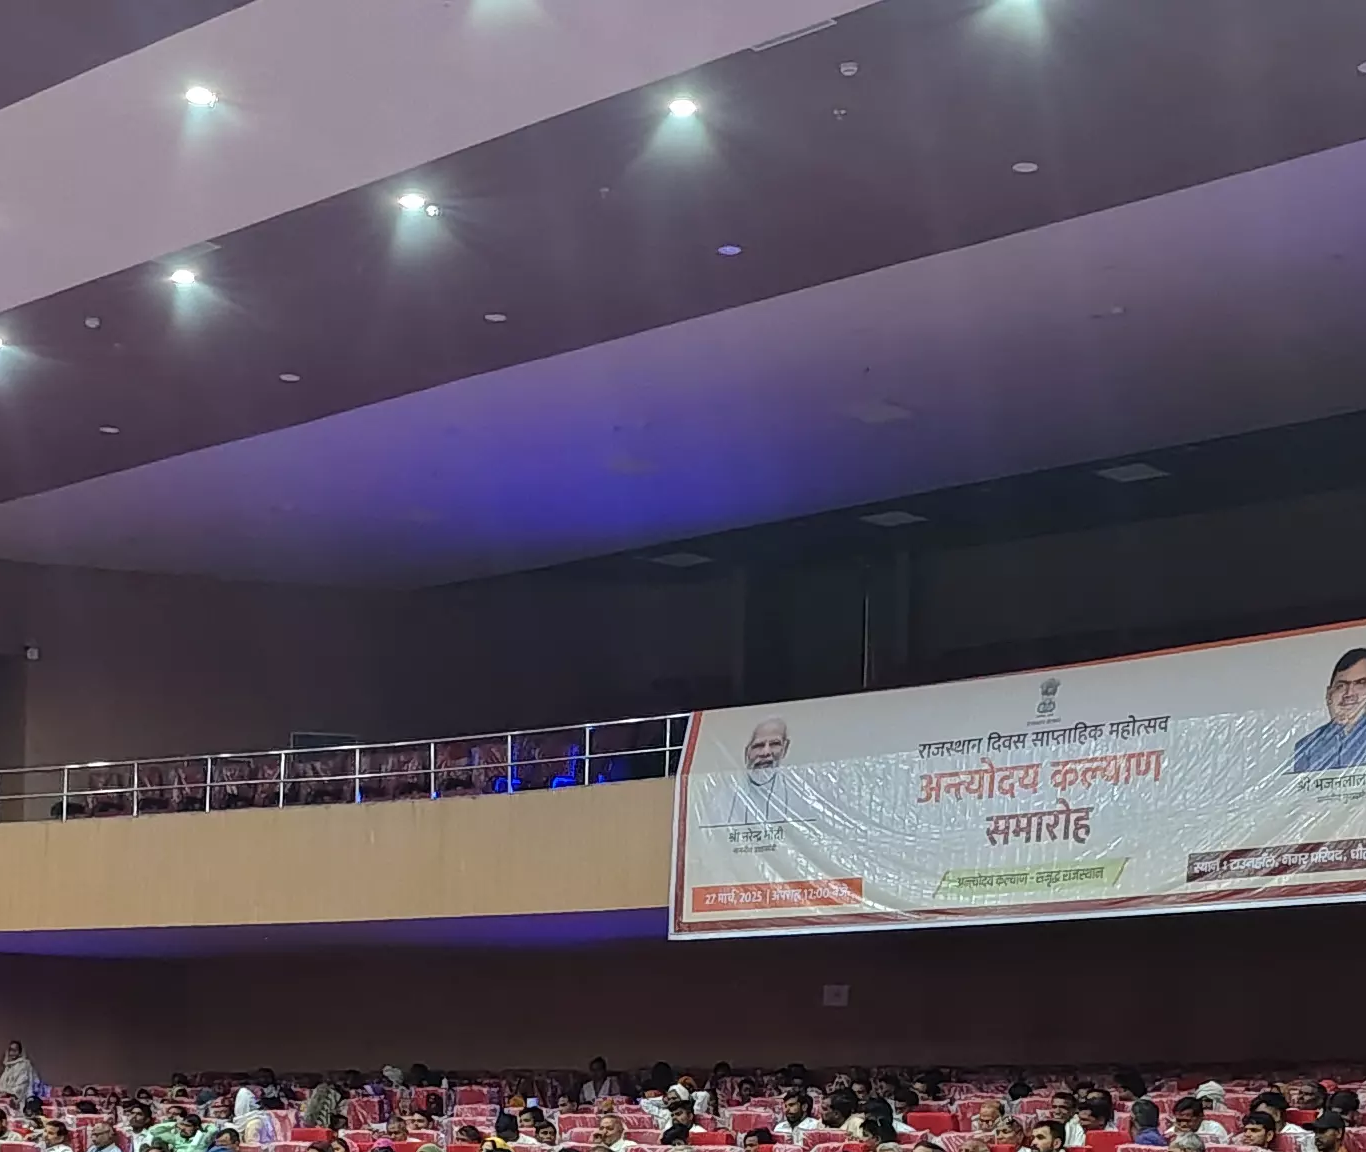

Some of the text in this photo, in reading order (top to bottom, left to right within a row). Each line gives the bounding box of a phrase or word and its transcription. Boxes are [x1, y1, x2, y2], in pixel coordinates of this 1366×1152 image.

[918, 715, 1171, 760] राजस्थान दिवस साप्ताहिक महोत्सव
[917, 750, 1165, 803] अन्त्योदय कल्याण
[1315, 774, 1366, 790] भजनलाल
[985, 798, 1094, 846] समारोह
[1063, 867, 1105, 882] राजस्थान
[705, 894, 716, 904] 27
[740, 891, 762, 903] 2025
[803, 886, 830, 900] 12:00
